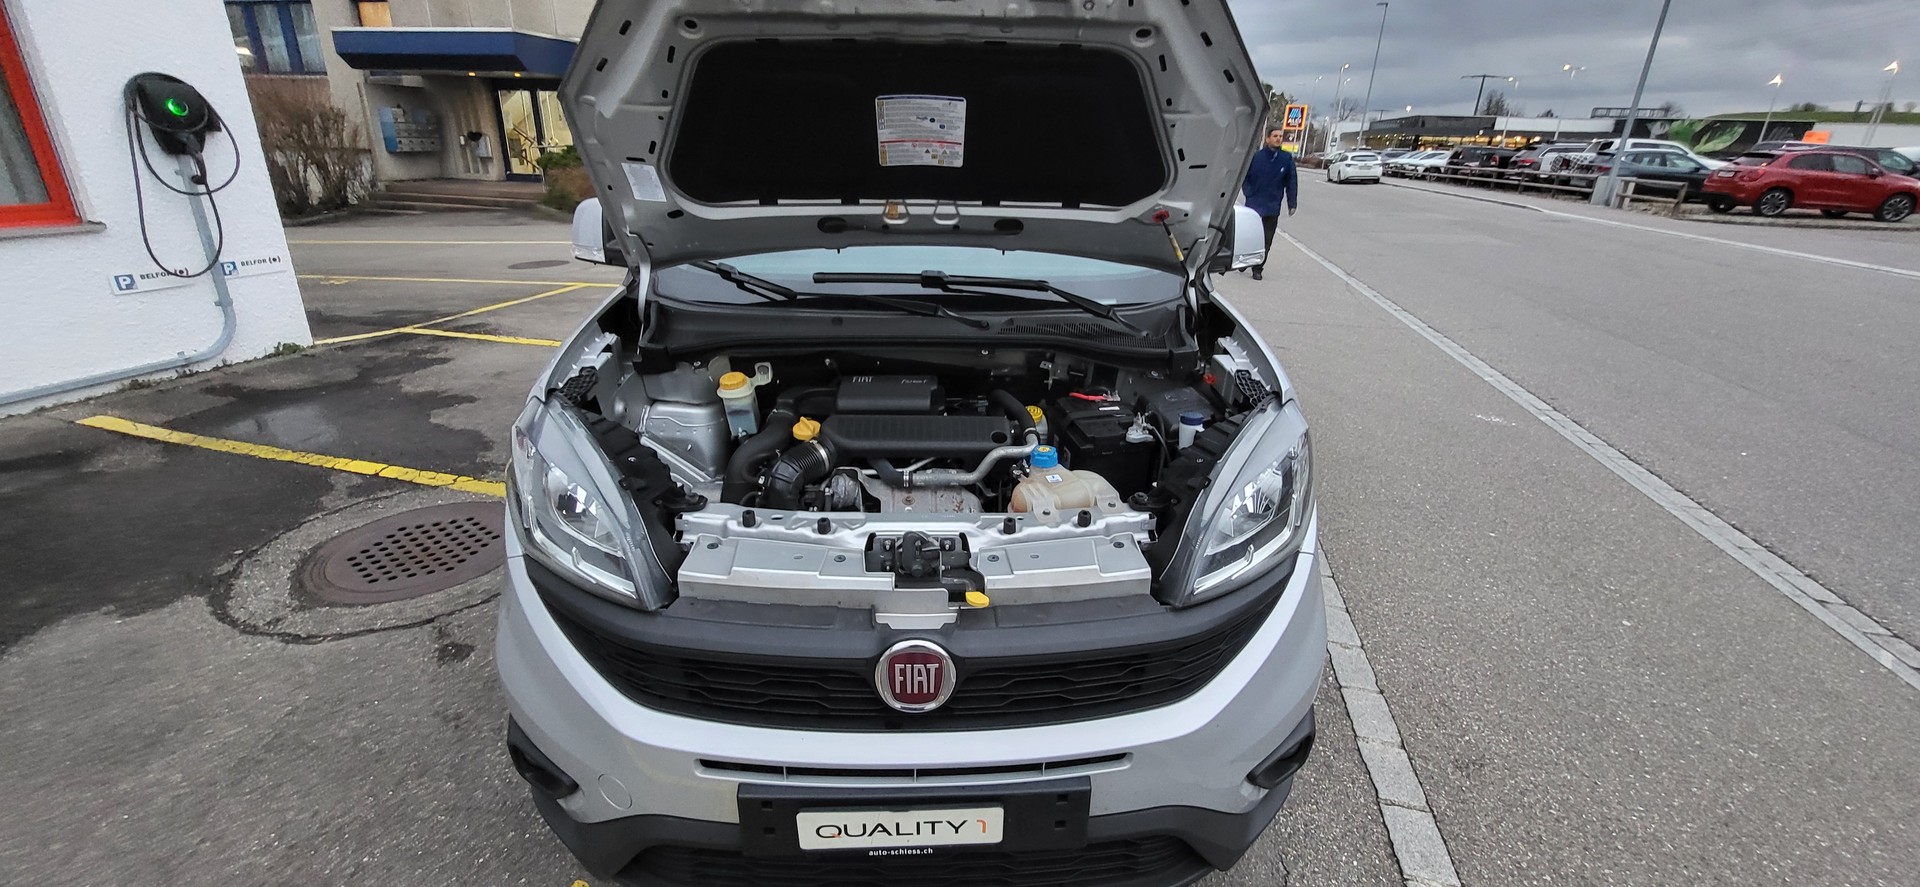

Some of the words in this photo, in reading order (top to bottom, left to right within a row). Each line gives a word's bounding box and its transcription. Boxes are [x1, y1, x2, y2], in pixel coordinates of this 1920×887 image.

[240, 258, 267, 267] BELFOR
[119, 276, 132, 289] P
[894, 663, 939, 694] FIAT
[815, 819, 968, 839] QUALITY
[976, 819, 987, 834] 1
